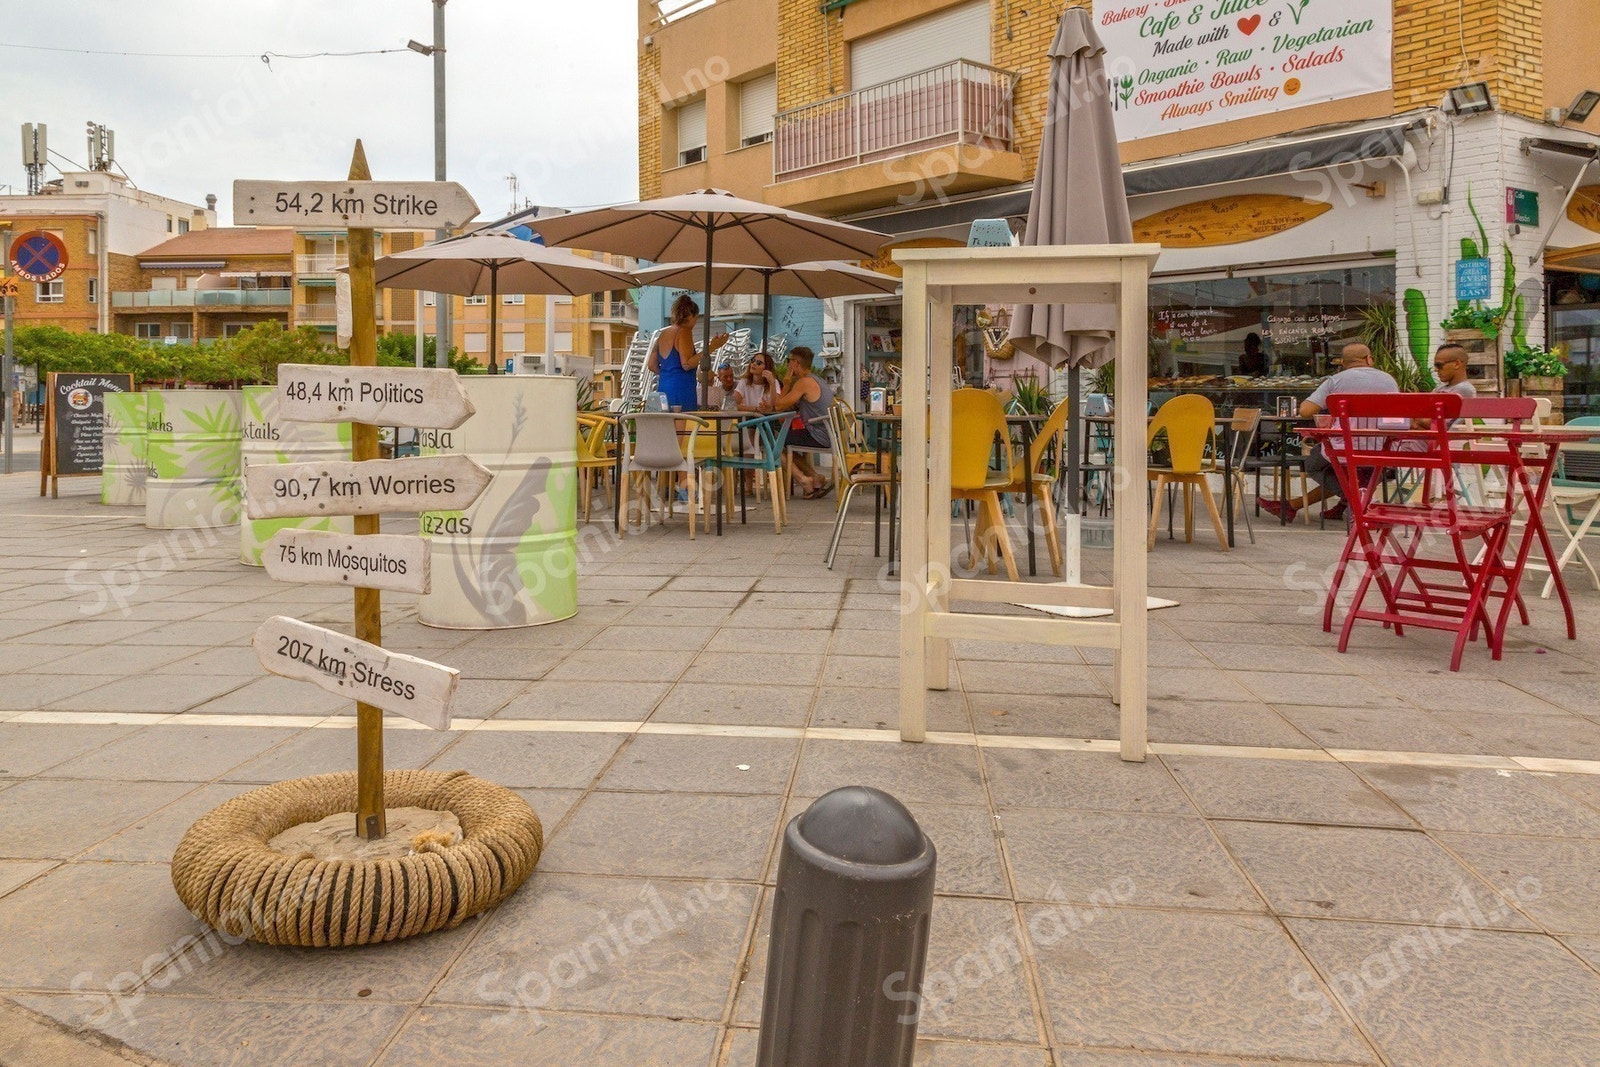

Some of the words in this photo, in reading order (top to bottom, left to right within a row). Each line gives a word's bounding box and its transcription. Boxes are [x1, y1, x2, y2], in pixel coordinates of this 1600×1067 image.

[1101, 4, 1150, 26] Bakery
[1139, 11, 1181, 38] Cafe
[1187, 4, 1204, 25] &
[1152, 39, 1194, 57] Made
[1197, 24, 1230, 45] with
[1268, 10, 1282, 27] &
[1138, 59, 1198, 86] Organic
[1216, 47, 1253, 67] Raw
[1272, 19, 1374, 54] Vegetarian
[1134, 75, 1205, 106] Smoothie
[1210, 64, 1263, 89] Bowls
[1282, 45, 1346, 73] Salads
[1160, 98, 1214, 121] Always
[1219, 83, 1279, 108] Smiling
[275, 192, 323, 216] 54,2
[332, 193, 365, 214] km
[373, 194, 438, 216] Strike
[11, 260, 36, 281] AMBOS
[40, 262, 65, 281] LADOS
[1460, 275, 1487, 283] EVER
[1460, 288, 1487, 297] EASY
[60, 378, 97, 395] Cocktail
[98, 377, 124, 394] Menu
[286, 382, 323, 404] 48,4
[328, 382, 353, 402] km
[360, 382, 424, 405] Politics
[273, 477, 321, 501] 90,7
[329, 477, 362, 497] km
[369, 474, 455, 495] Worries
[420, 511, 472, 534] izzas
[279, 544, 296, 564] 75
[301, 547, 323, 568] km
[327, 548, 407, 575] Mosquitos
[276, 635, 314, 663] 207
[318, 648, 346, 677] km
[352, 661, 415, 701] Stress
